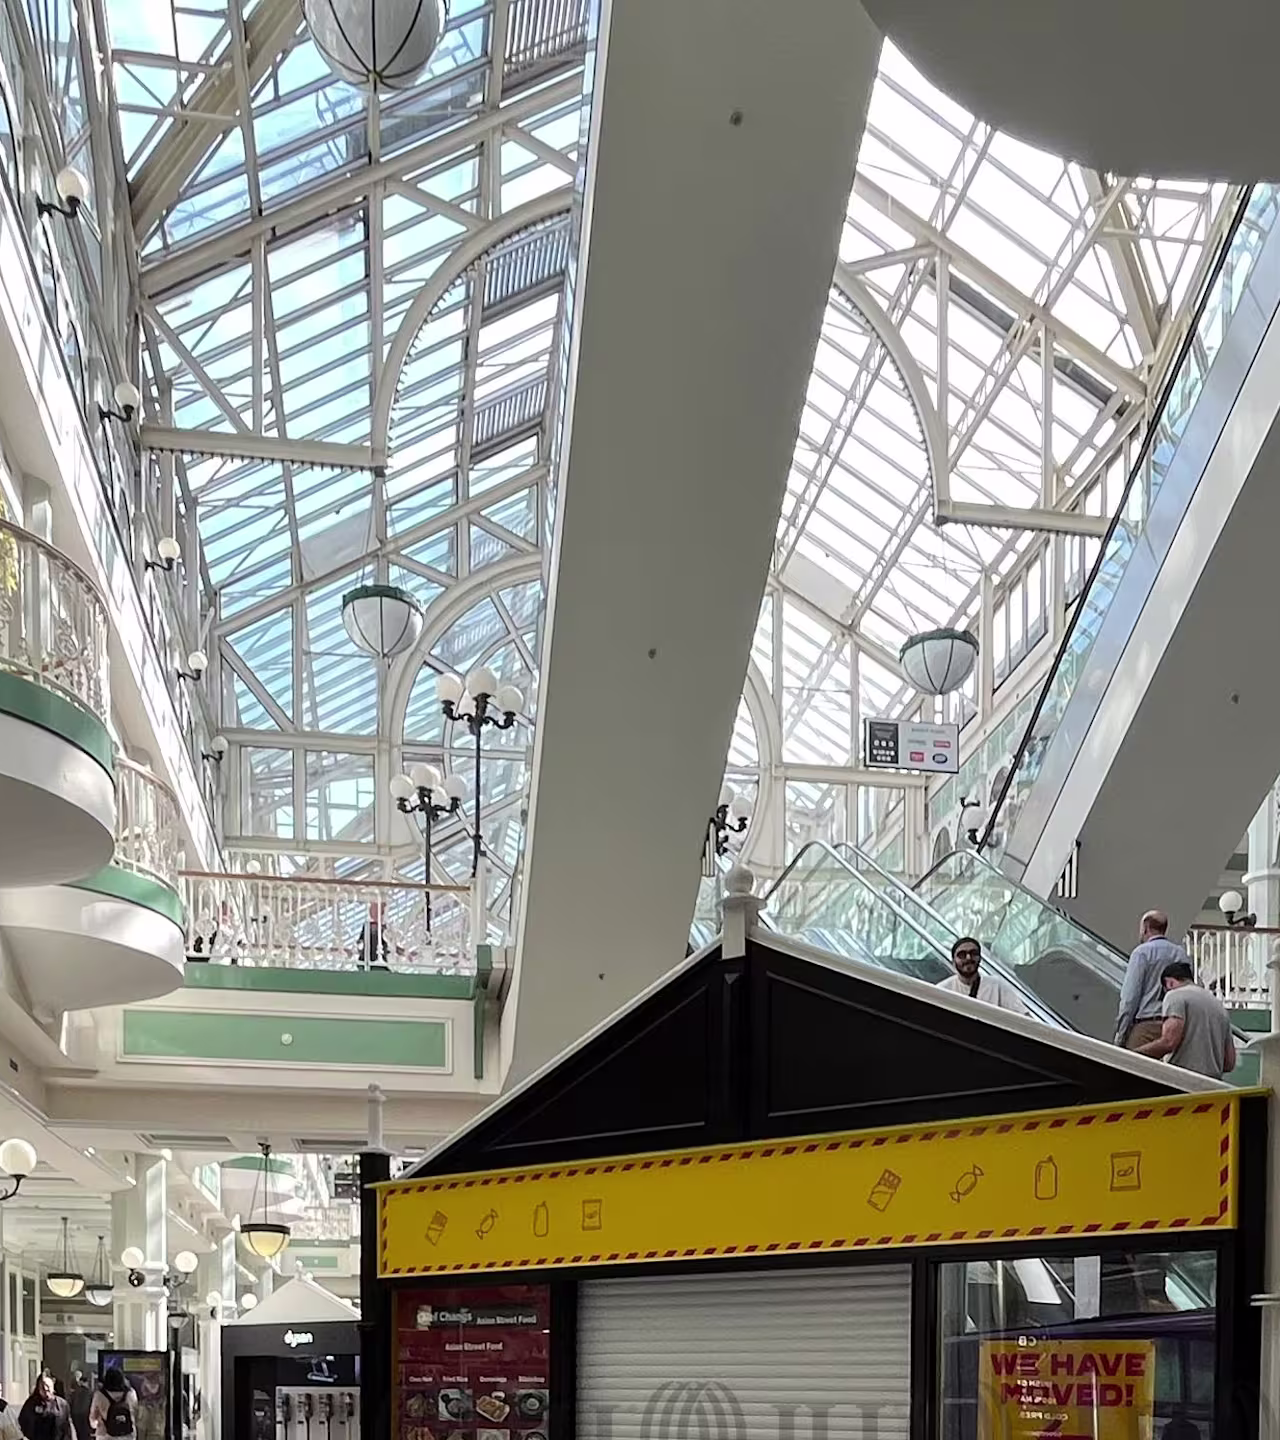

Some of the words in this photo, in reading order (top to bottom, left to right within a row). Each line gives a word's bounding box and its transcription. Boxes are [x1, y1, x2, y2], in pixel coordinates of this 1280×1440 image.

[991, 1353, 1041, 1377] WE
[1050, 1353, 1146, 1377] HAVE
[1000, 1382, 1135, 1407] MOVED!
